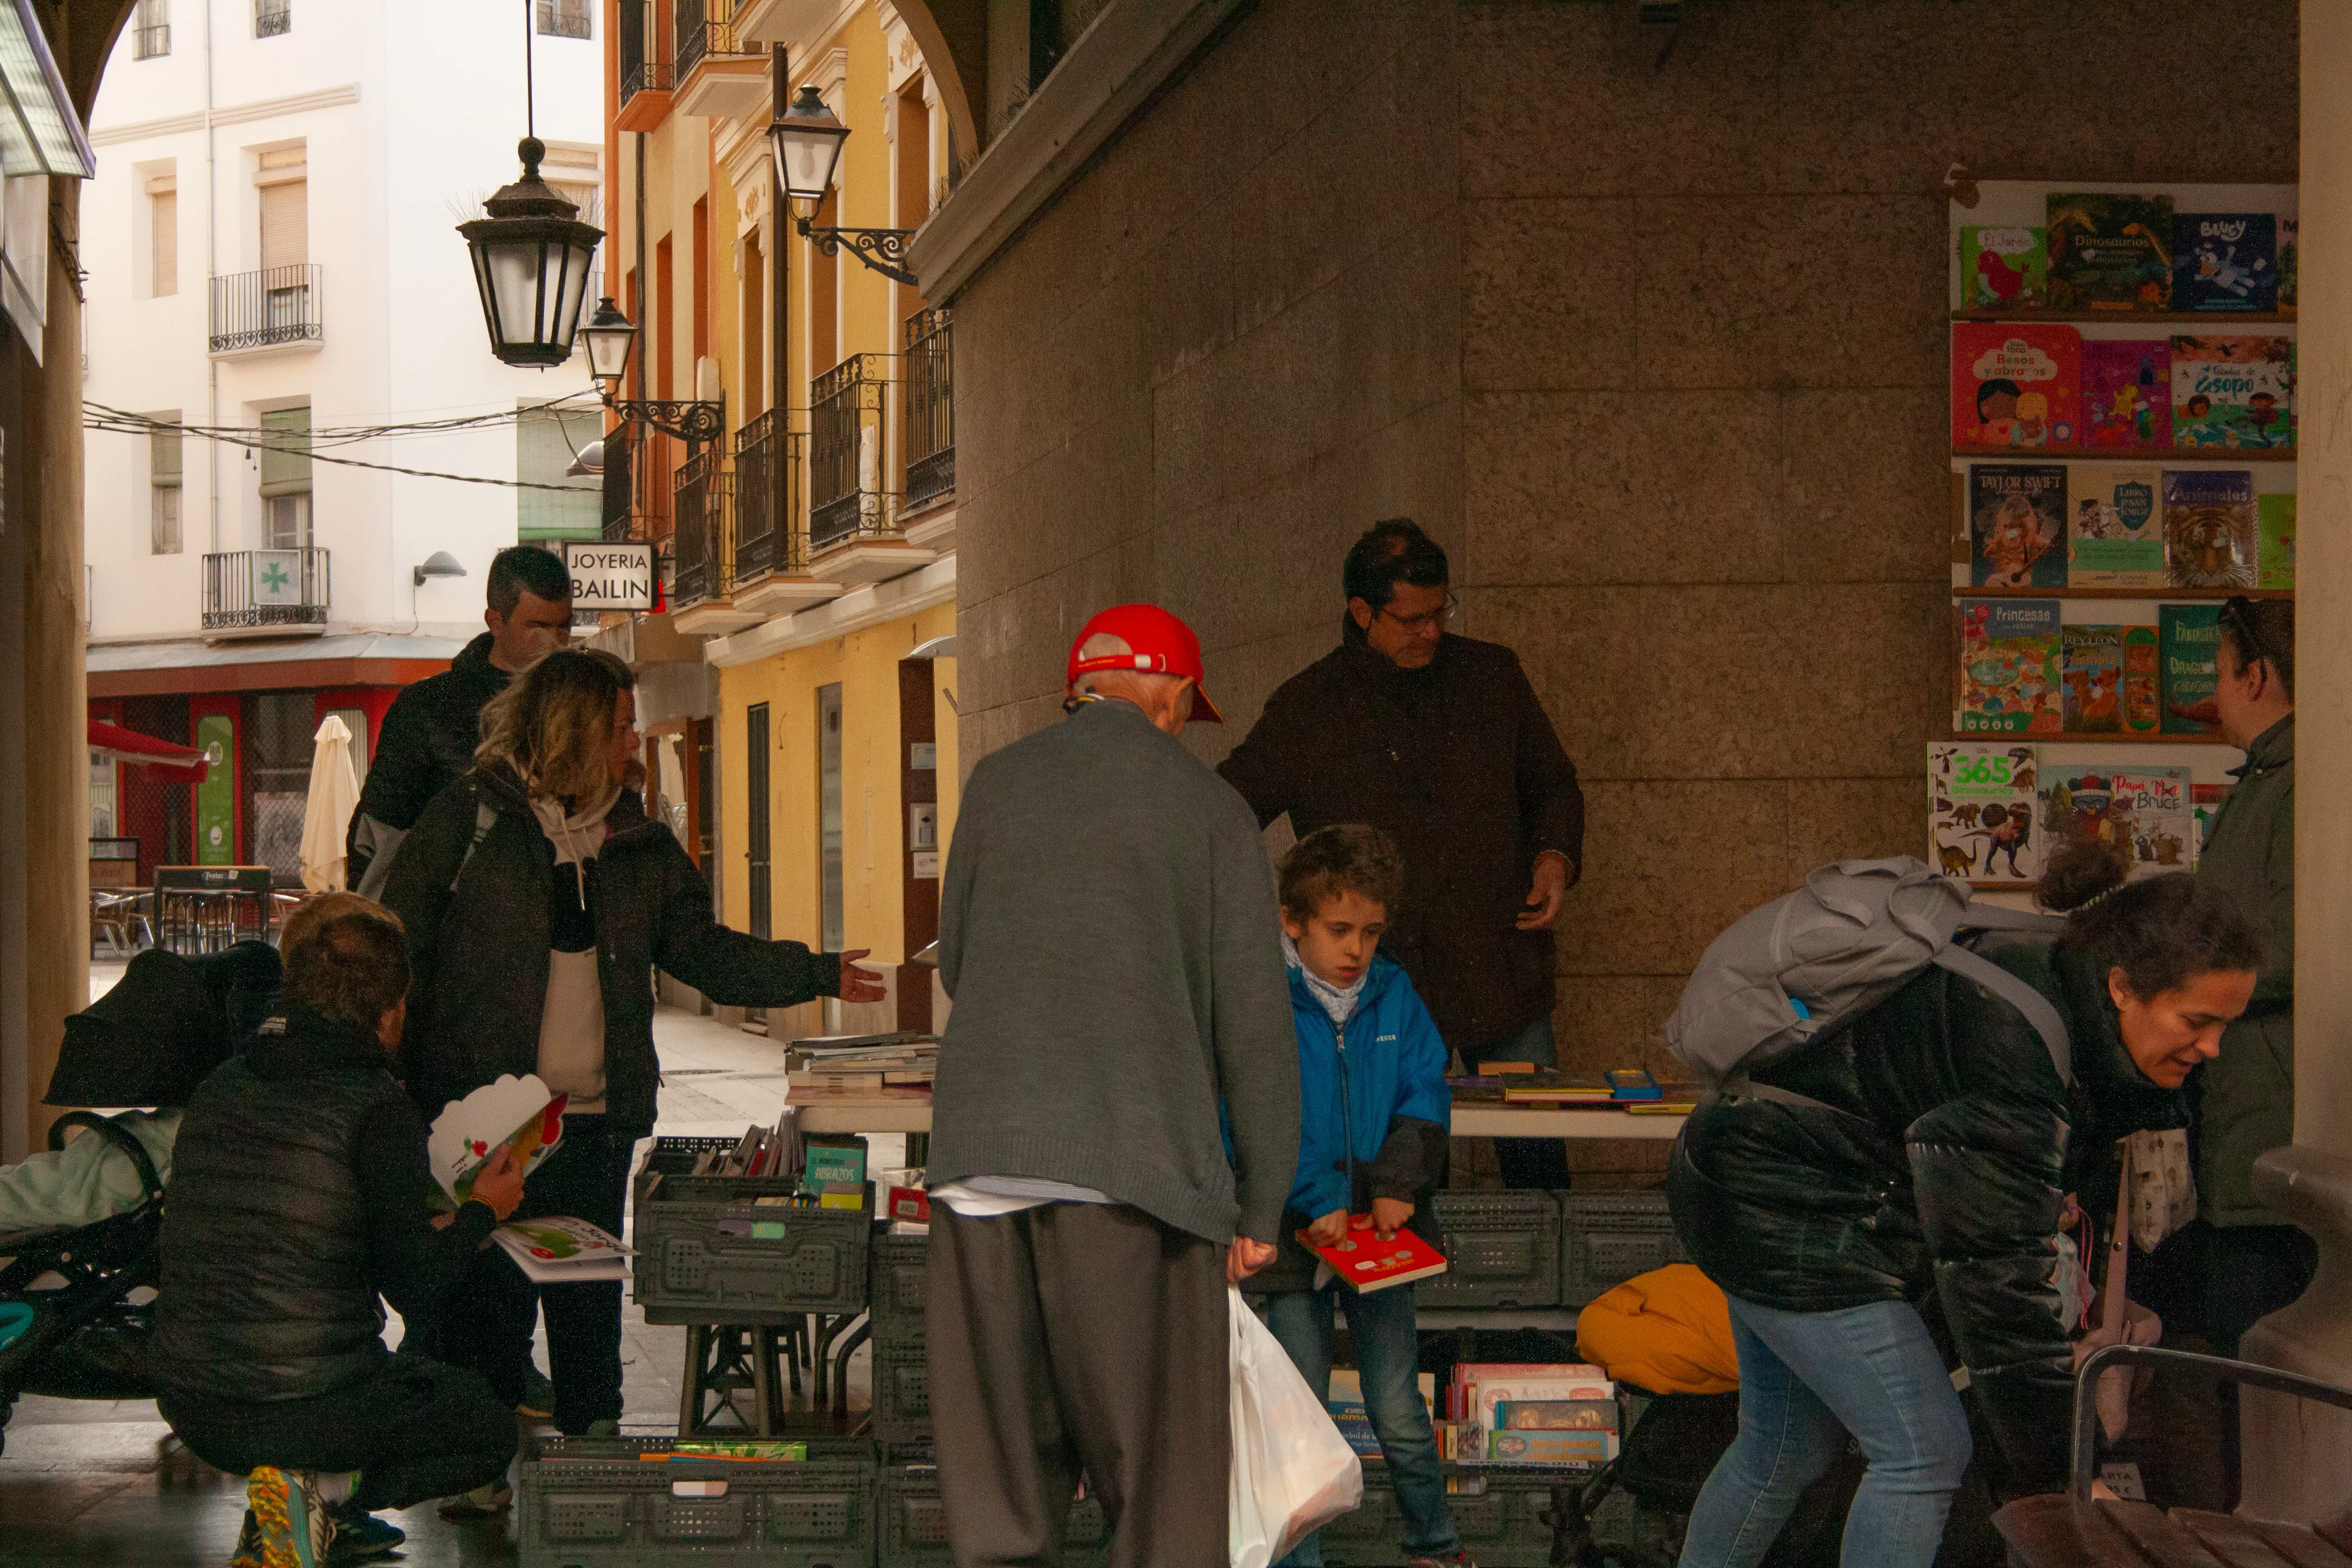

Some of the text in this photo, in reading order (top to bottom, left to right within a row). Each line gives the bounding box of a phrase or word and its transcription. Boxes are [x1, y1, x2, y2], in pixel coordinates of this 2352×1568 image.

[2075, 235, 2149, 247] Dinosaurios
[1996, 354, 2034, 364] Besos
[1980, 475, 2062, 489] TAYLOR SWIFT
[572, 554, 647, 569] JOYERIA
[572, 579, 648, 599] BAILIN
[1996, 606, 2051, 622] Princesas
[2064, 635, 2087, 645] REY
[1954, 756, 2011, 783] 365
[814, 1167, 855, 1182] ABRAZOS
